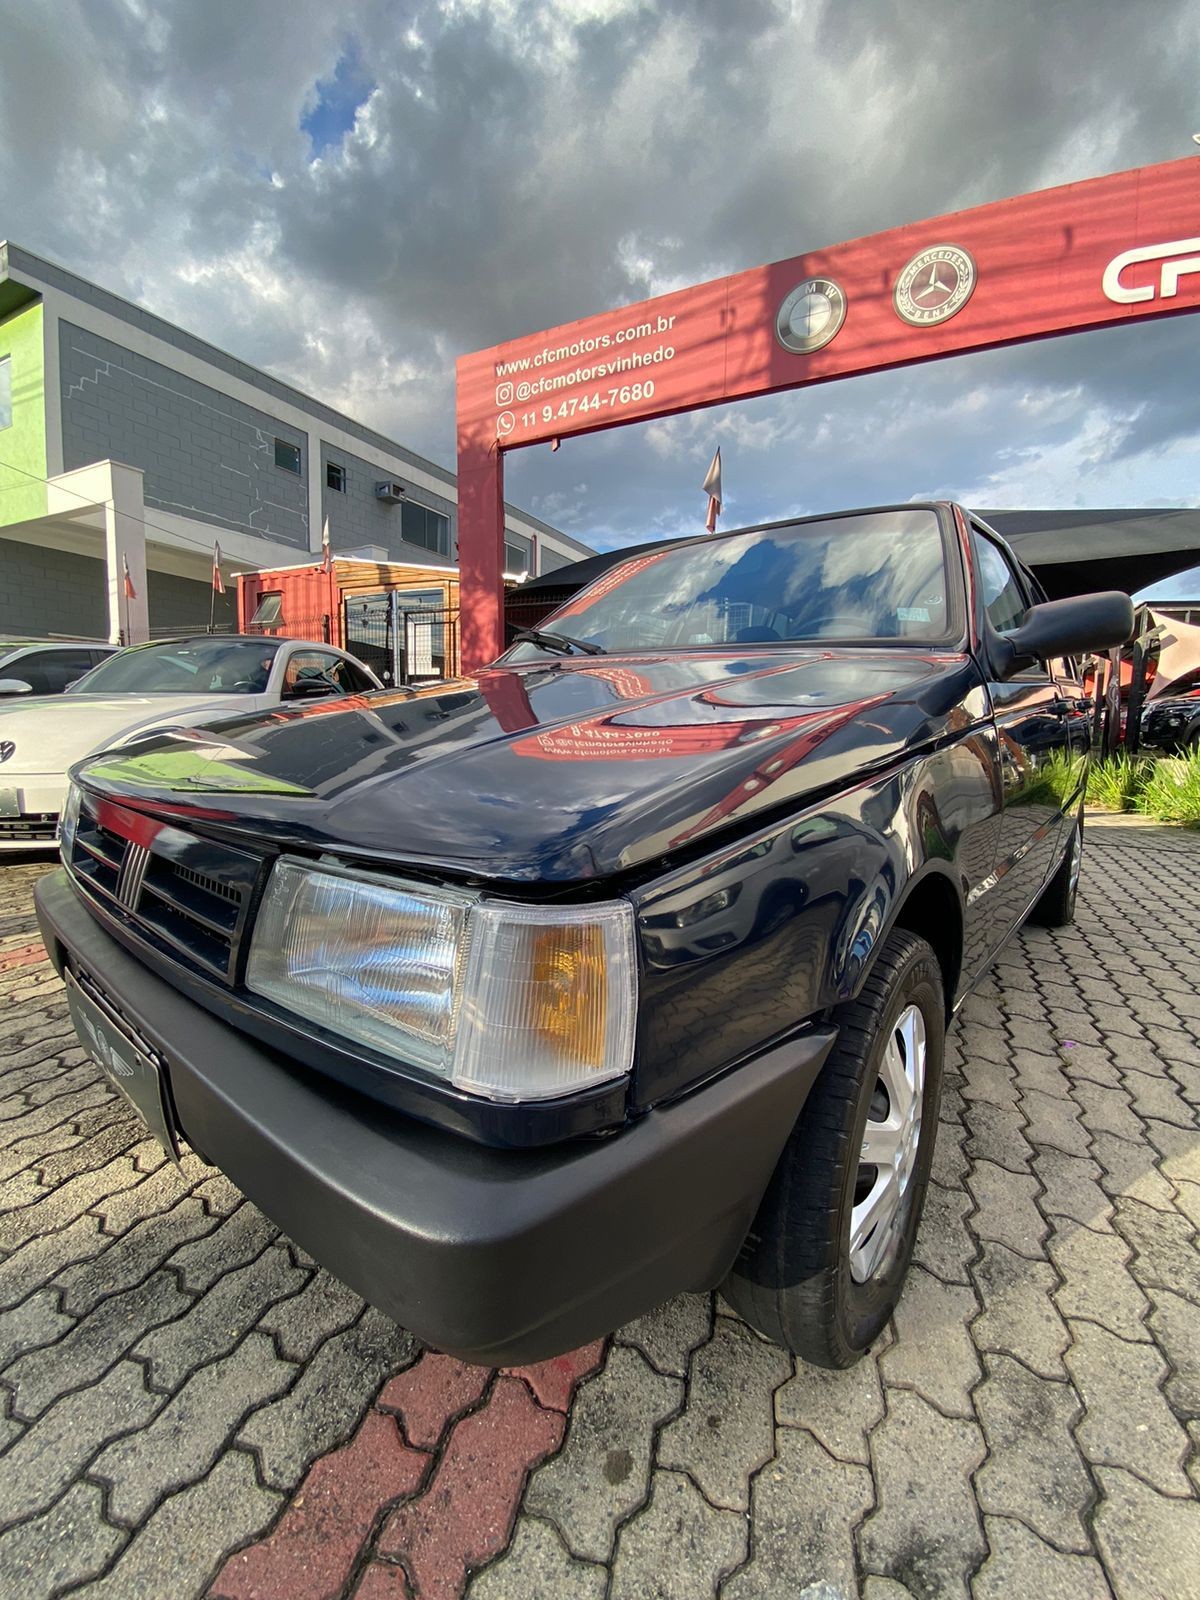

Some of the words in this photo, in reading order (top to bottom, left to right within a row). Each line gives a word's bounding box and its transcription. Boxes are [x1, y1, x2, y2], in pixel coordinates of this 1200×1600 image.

[908, 251, 963, 275] MERCEDES
[914, 304, 951, 319] BENZ
[495, 315, 677, 377] www.cfcmotors.com.br
[516, 346, 676, 401] @cfcmotorsvinhedo
[521, 410, 537, 427] 11
[541, 380, 656, 422] 9.4744-7680
